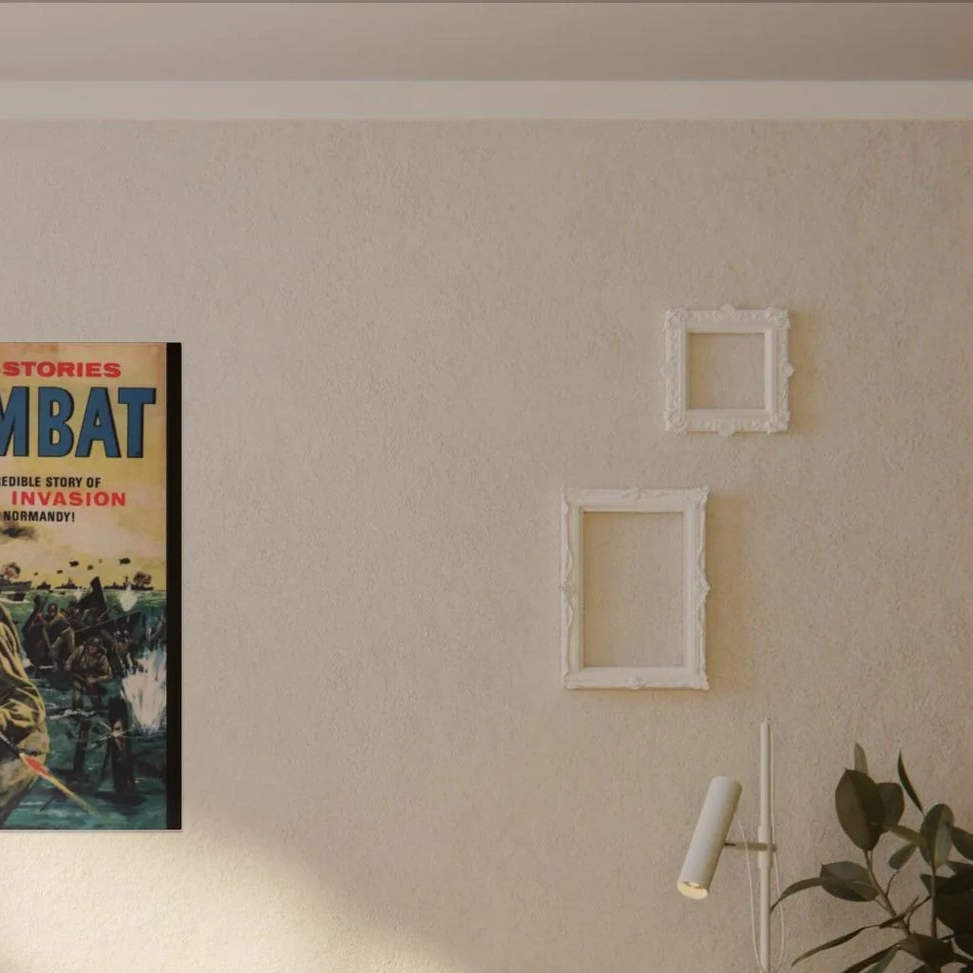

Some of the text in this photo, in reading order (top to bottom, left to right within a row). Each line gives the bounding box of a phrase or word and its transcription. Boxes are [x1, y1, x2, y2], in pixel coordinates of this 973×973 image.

[46, 477, 82, 488] STORY
[87, 478, 101, 489] OF
[12, 493, 126, 507] INVASION
[4, 511, 75, 523] NORMANDY!
